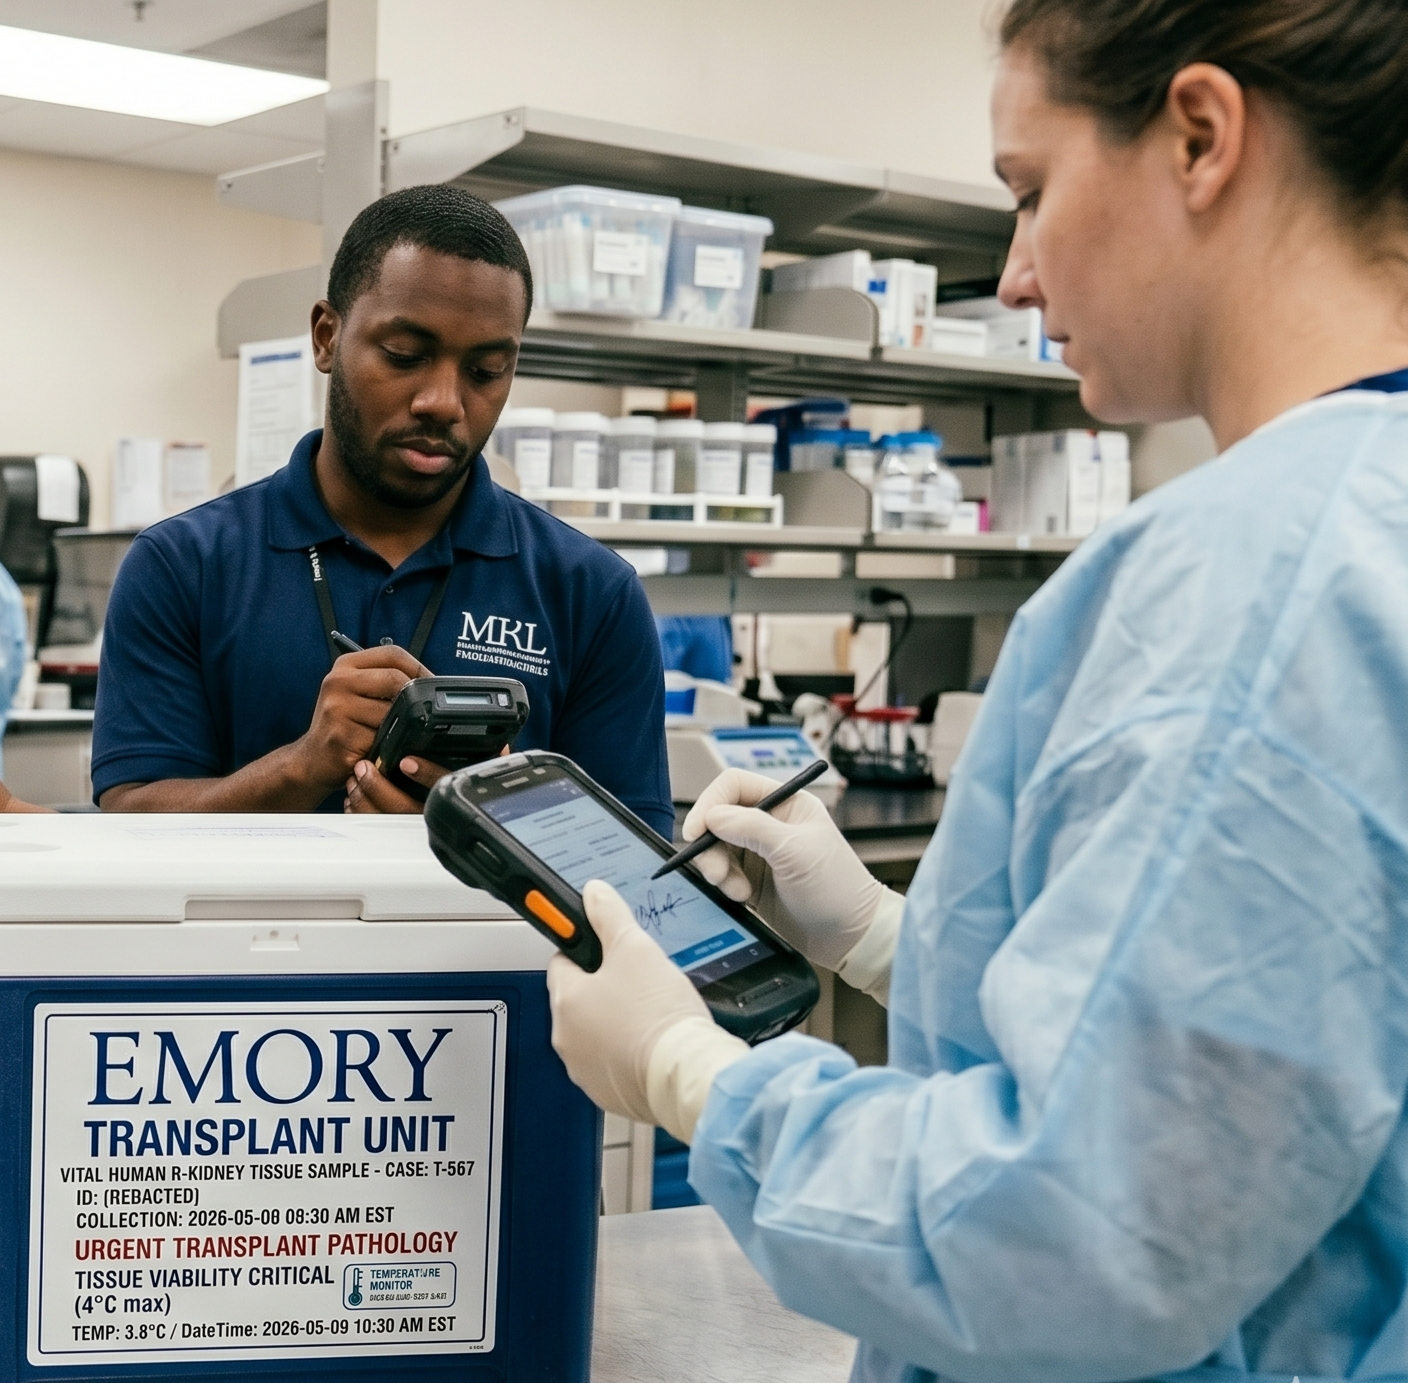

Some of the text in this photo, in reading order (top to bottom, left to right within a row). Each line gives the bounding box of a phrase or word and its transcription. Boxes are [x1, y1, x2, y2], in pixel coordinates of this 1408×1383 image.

[88, 1028, 453, 1105] EMORY
[84, 1115, 455, 1158] TRANSPLANT UNIT
[60, 1167, 103, 1183] VITAL
[109, 1166, 166, 1182] HUMAN
[171, 1165, 245, 1182] R-KIDNEY
[250, 1163, 303, 1180] TISSUE
[308, 1162, 370, 1179] SAMPLE
[385, 1161, 429, 1178] CASE:
[433, 1160, 475, 1177] T-567
[76, 1188, 200, 1208] ID: (REBACTED)
[76, 1211, 183, 1229] COLLECTION:
[285, 1208, 329, 1225] 08:30
[334, 1207, 360, 1224] AM
[365, 1206, 395, 1223] EST
[75, 1231, 458, 1260] URGENT TRANSPLANT PATHOLOGY
[75, 1265, 335, 1289] TISSUE VIABILITY CRITICAL
[369, 1280, 413, 1291] MONITOR
[74, 1293, 171, 1318] (4°C max)
[72, 1316, 456, 1341] TEMP: 3.8°C / DateTime: 2026-05-09 10:30 AM EST
